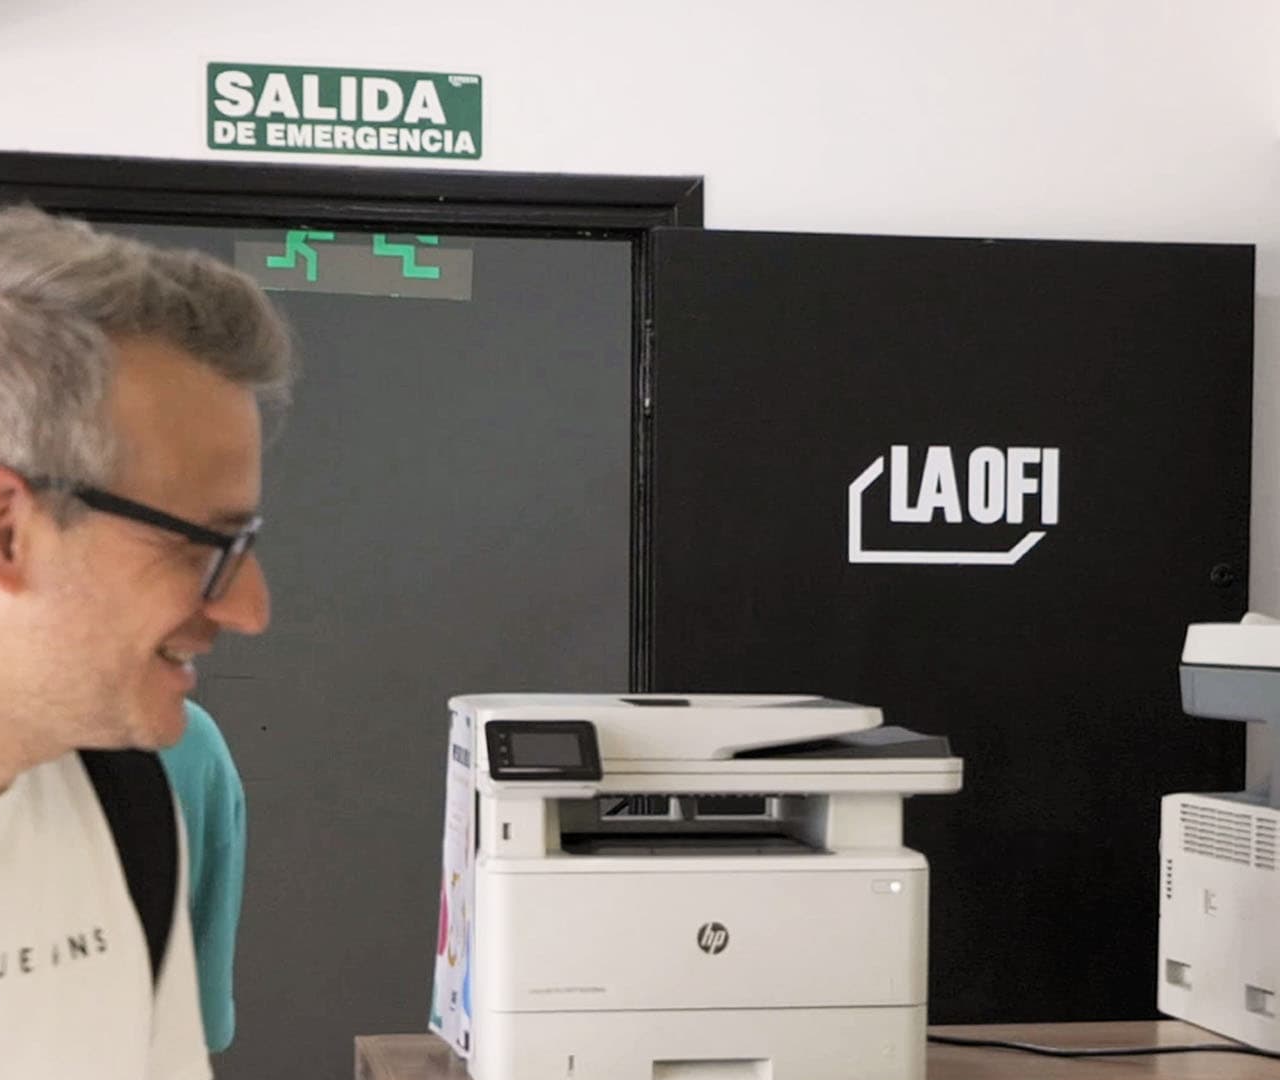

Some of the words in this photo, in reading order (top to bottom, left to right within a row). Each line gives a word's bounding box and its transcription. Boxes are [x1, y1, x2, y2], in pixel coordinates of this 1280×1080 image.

[214, 70, 447, 124] SALIDA
[213, 121, 257, 145] DE
[266, 122, 477, 154] EMERGENCIA
[890, 445, 963, 523] LA
[968, 446, 1059, 525] OFI
[699, 921, 728, 954] hp
